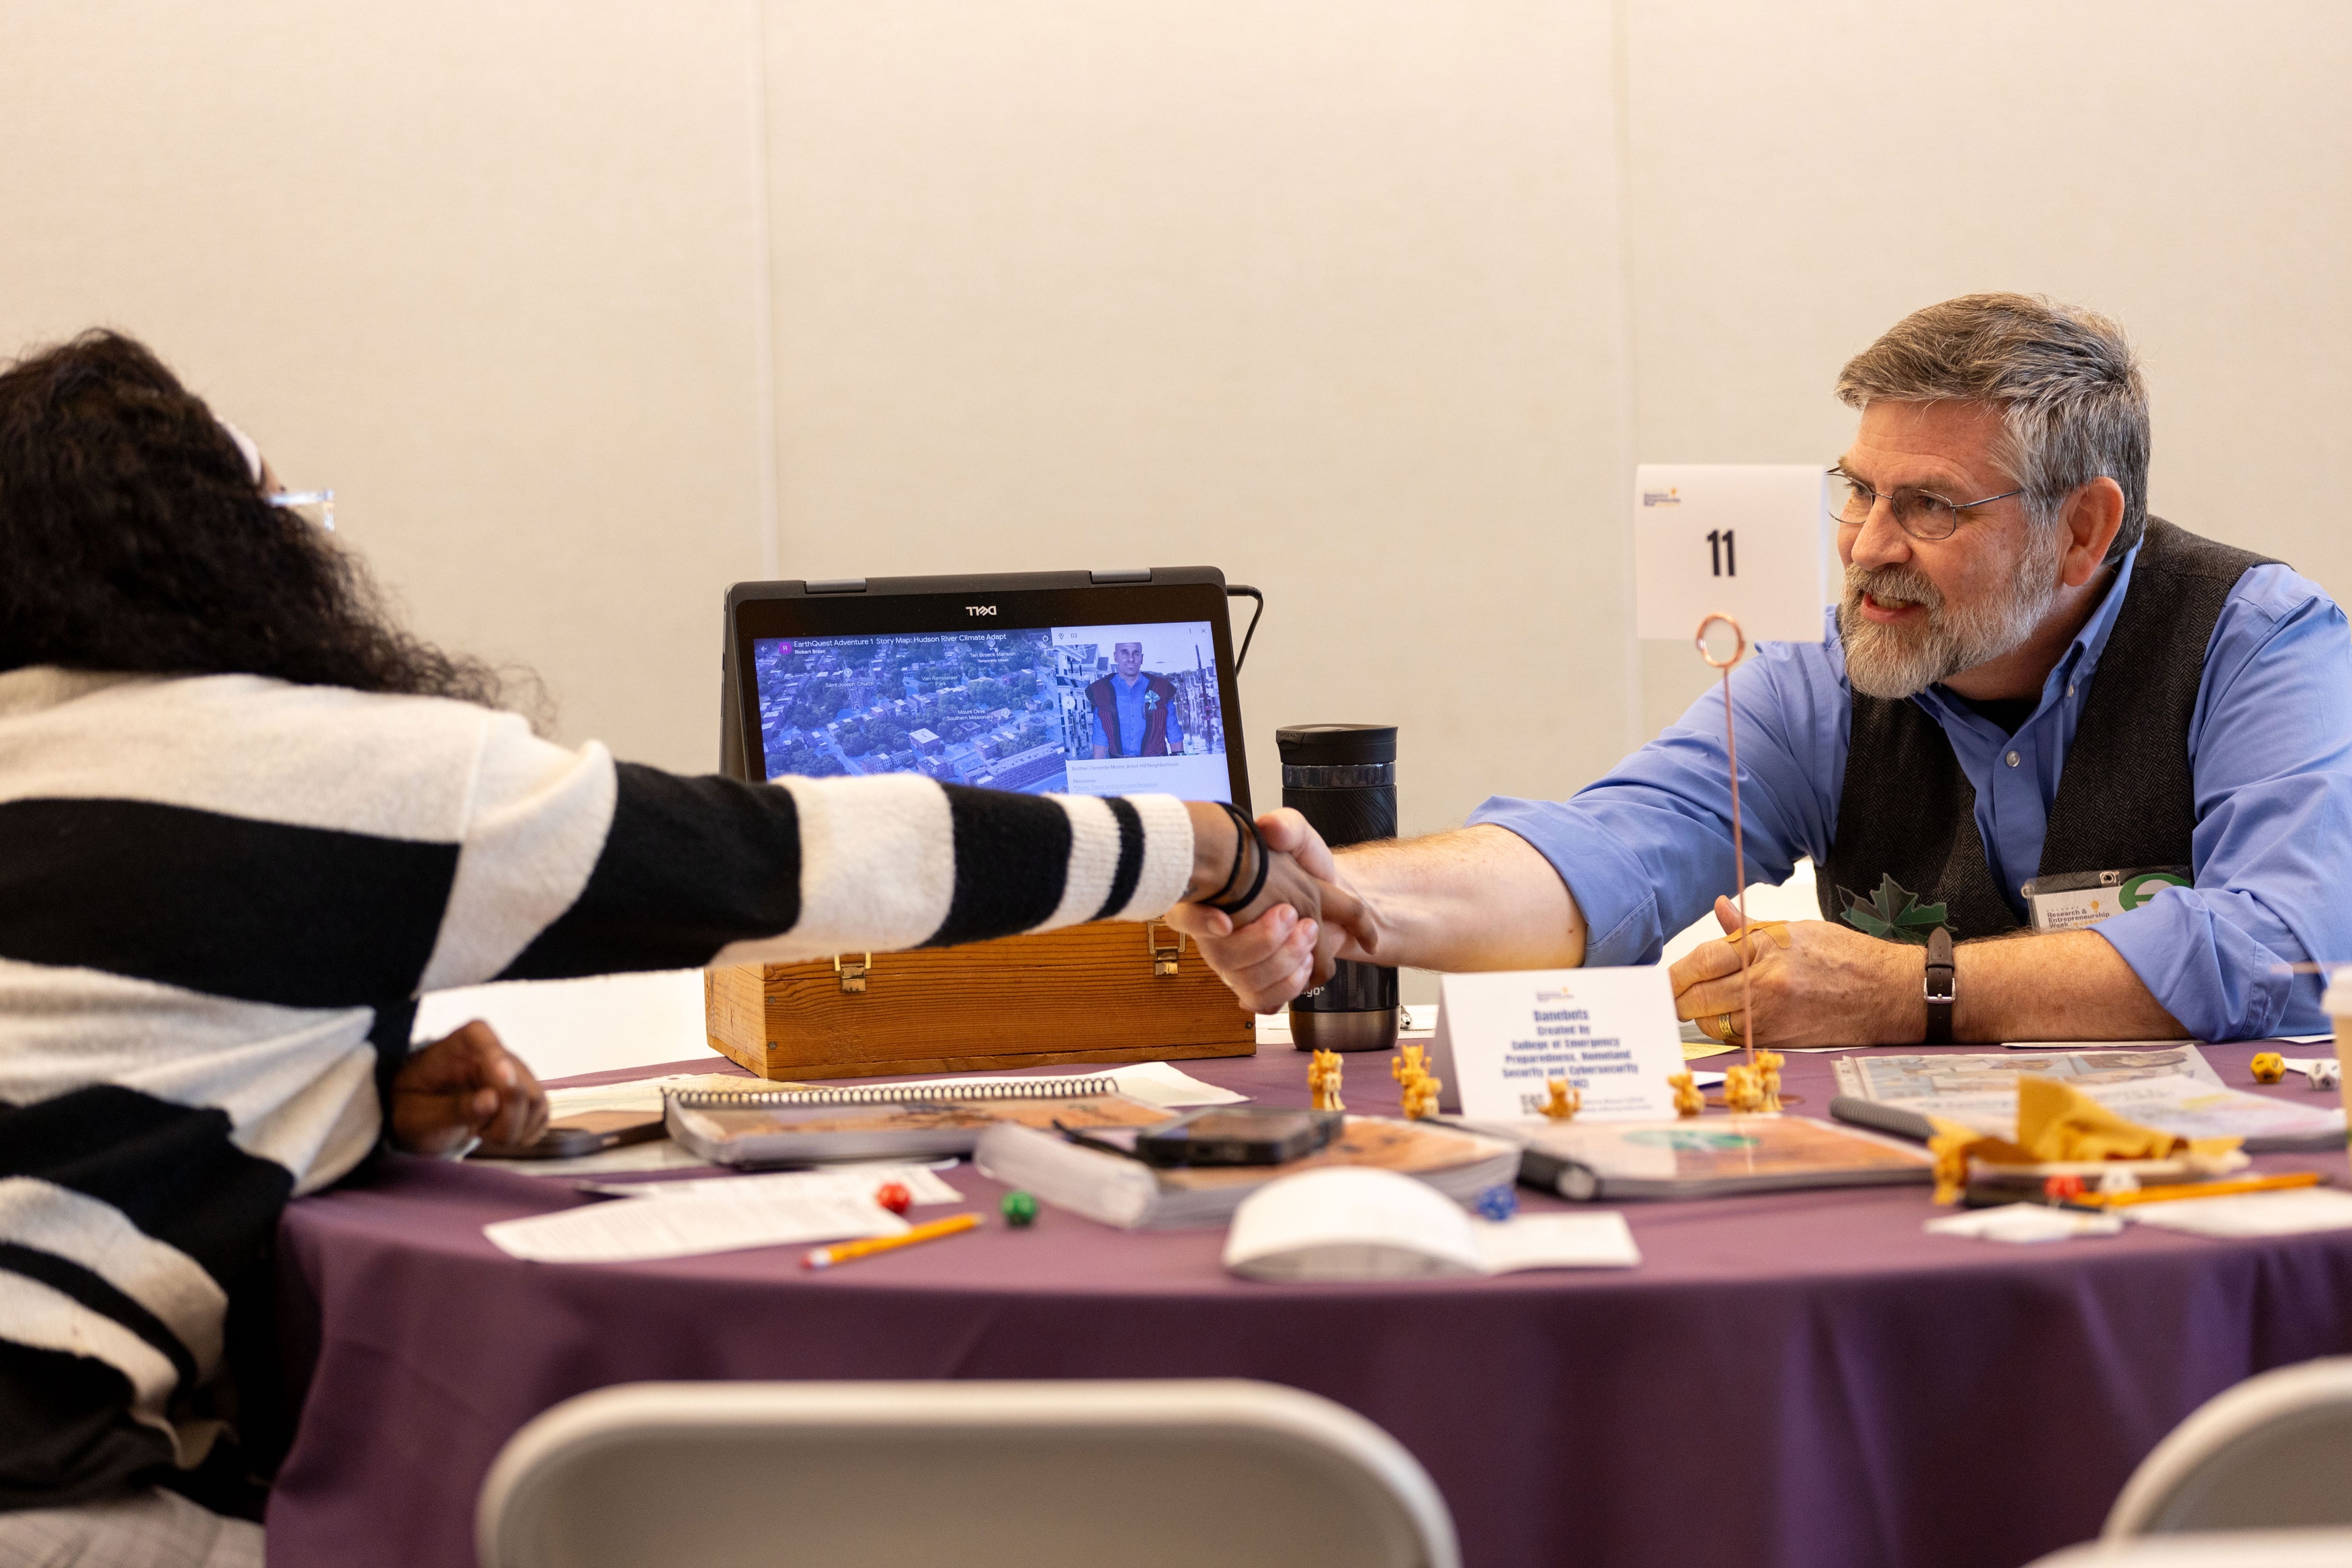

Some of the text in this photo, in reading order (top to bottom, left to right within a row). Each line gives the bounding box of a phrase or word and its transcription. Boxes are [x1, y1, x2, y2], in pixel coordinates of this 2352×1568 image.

[1707, 529, 1736, 577] 11
[966, 605, 997, 616] DELL
[876, 638, 894, 646] Story
[986, 634, 1006, 642] Adapt
[2047, 910, 2080, 918] Research
[2048, 912, 2110, 924] Entrepreneurship
[1511, 1041, 1548, 1050] College
[1564, 1038, 1620, 1049] Emergency
[1502, 1063, 1638, 1078] Security and Cybersecurity
